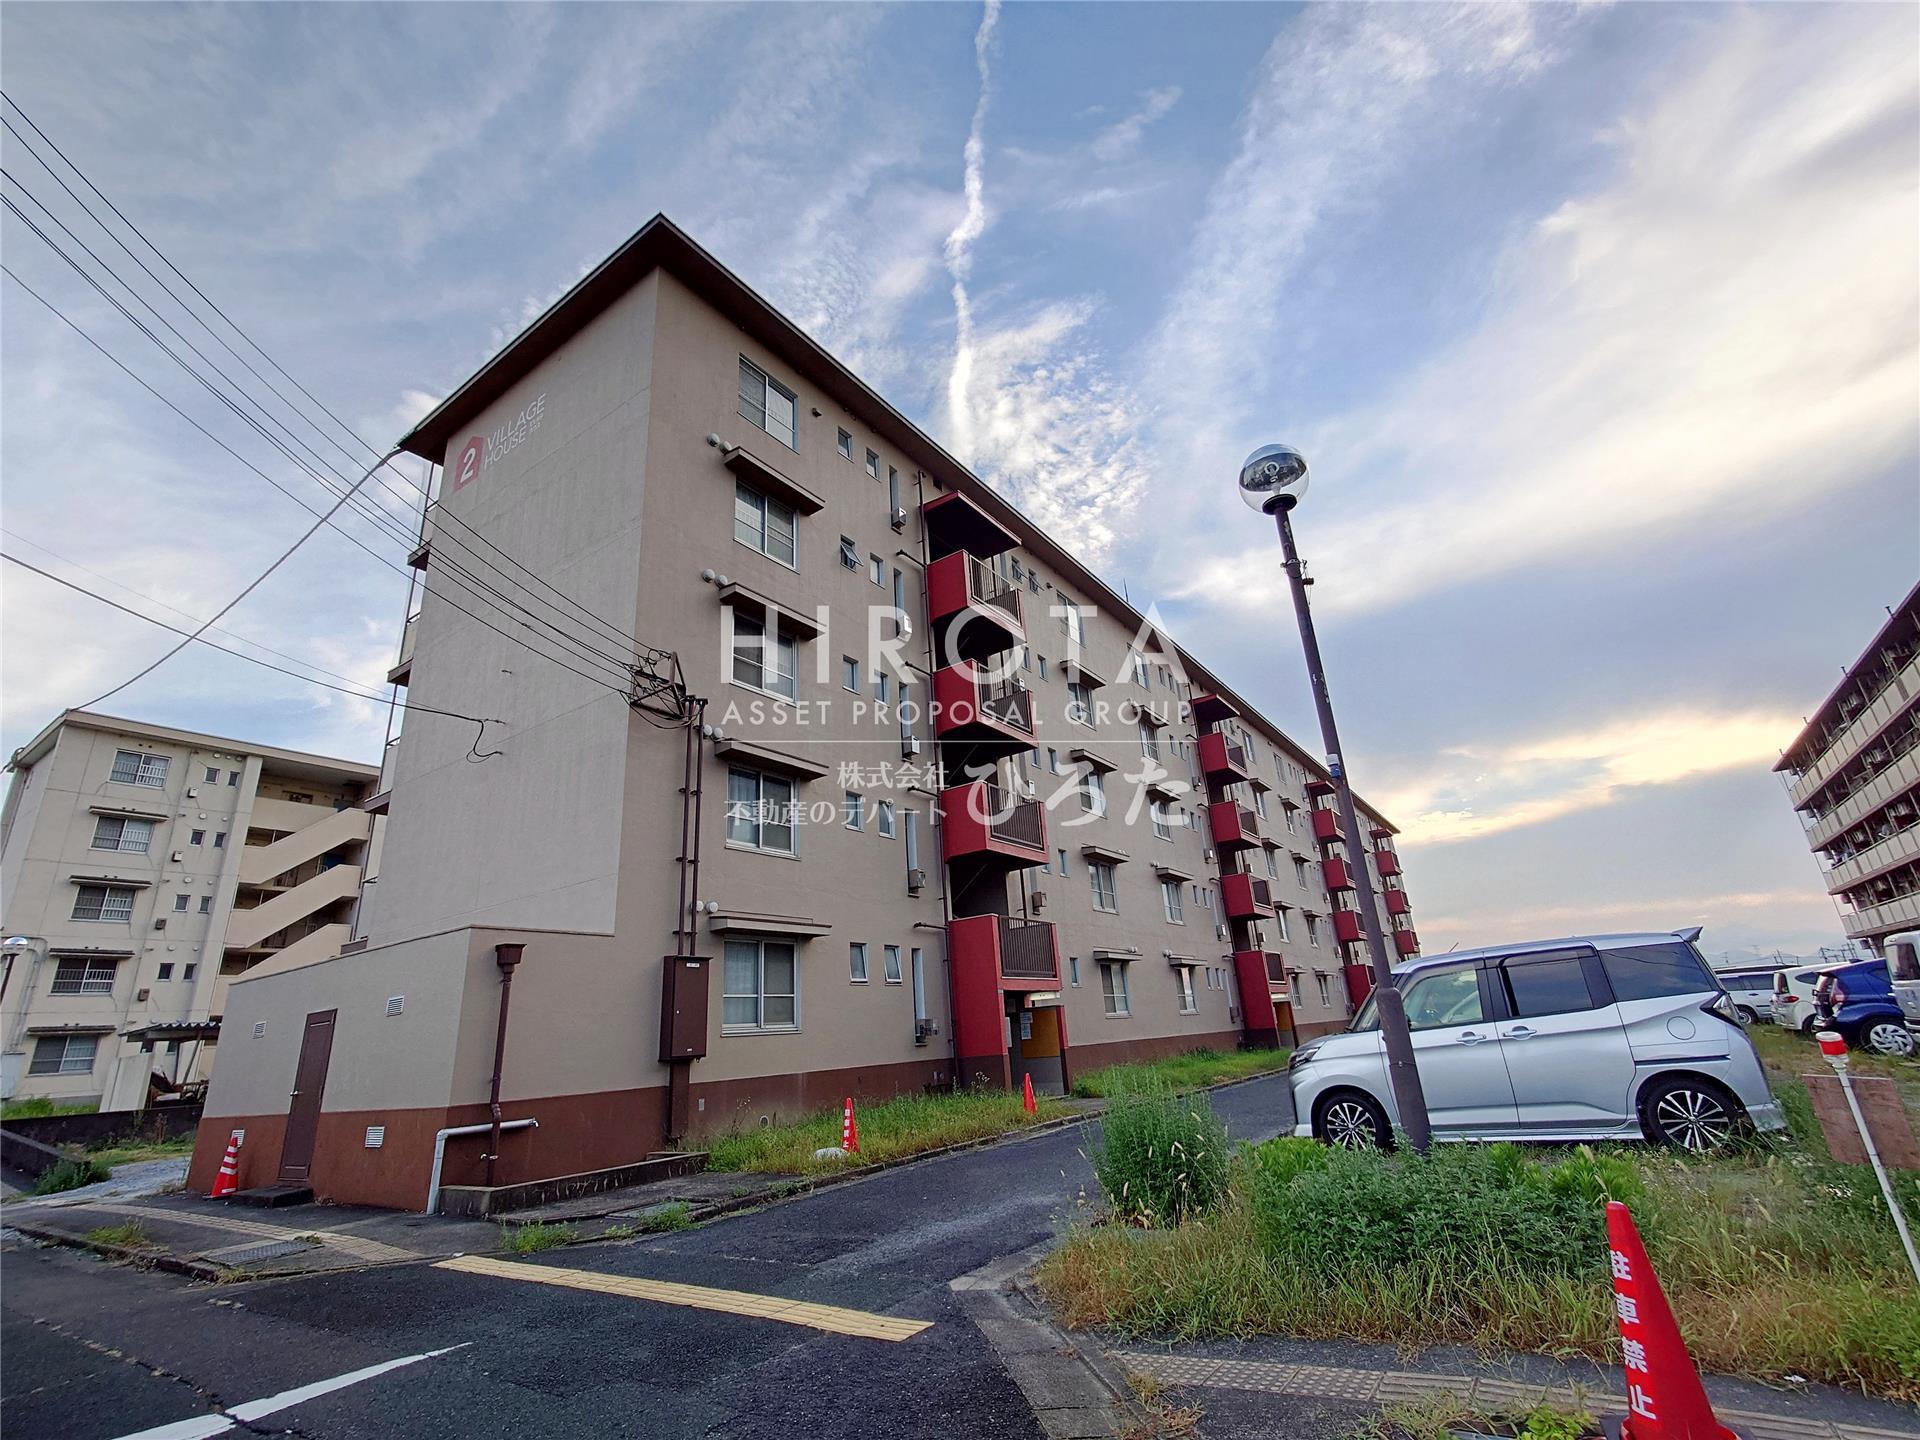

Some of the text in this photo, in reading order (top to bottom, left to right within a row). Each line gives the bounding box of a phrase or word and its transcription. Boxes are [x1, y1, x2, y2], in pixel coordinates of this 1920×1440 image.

[487, 393, 546, 450] VILLAGE
[460, 447, 476, 483] 2
[484, 425, 527, 470] HOUSE
